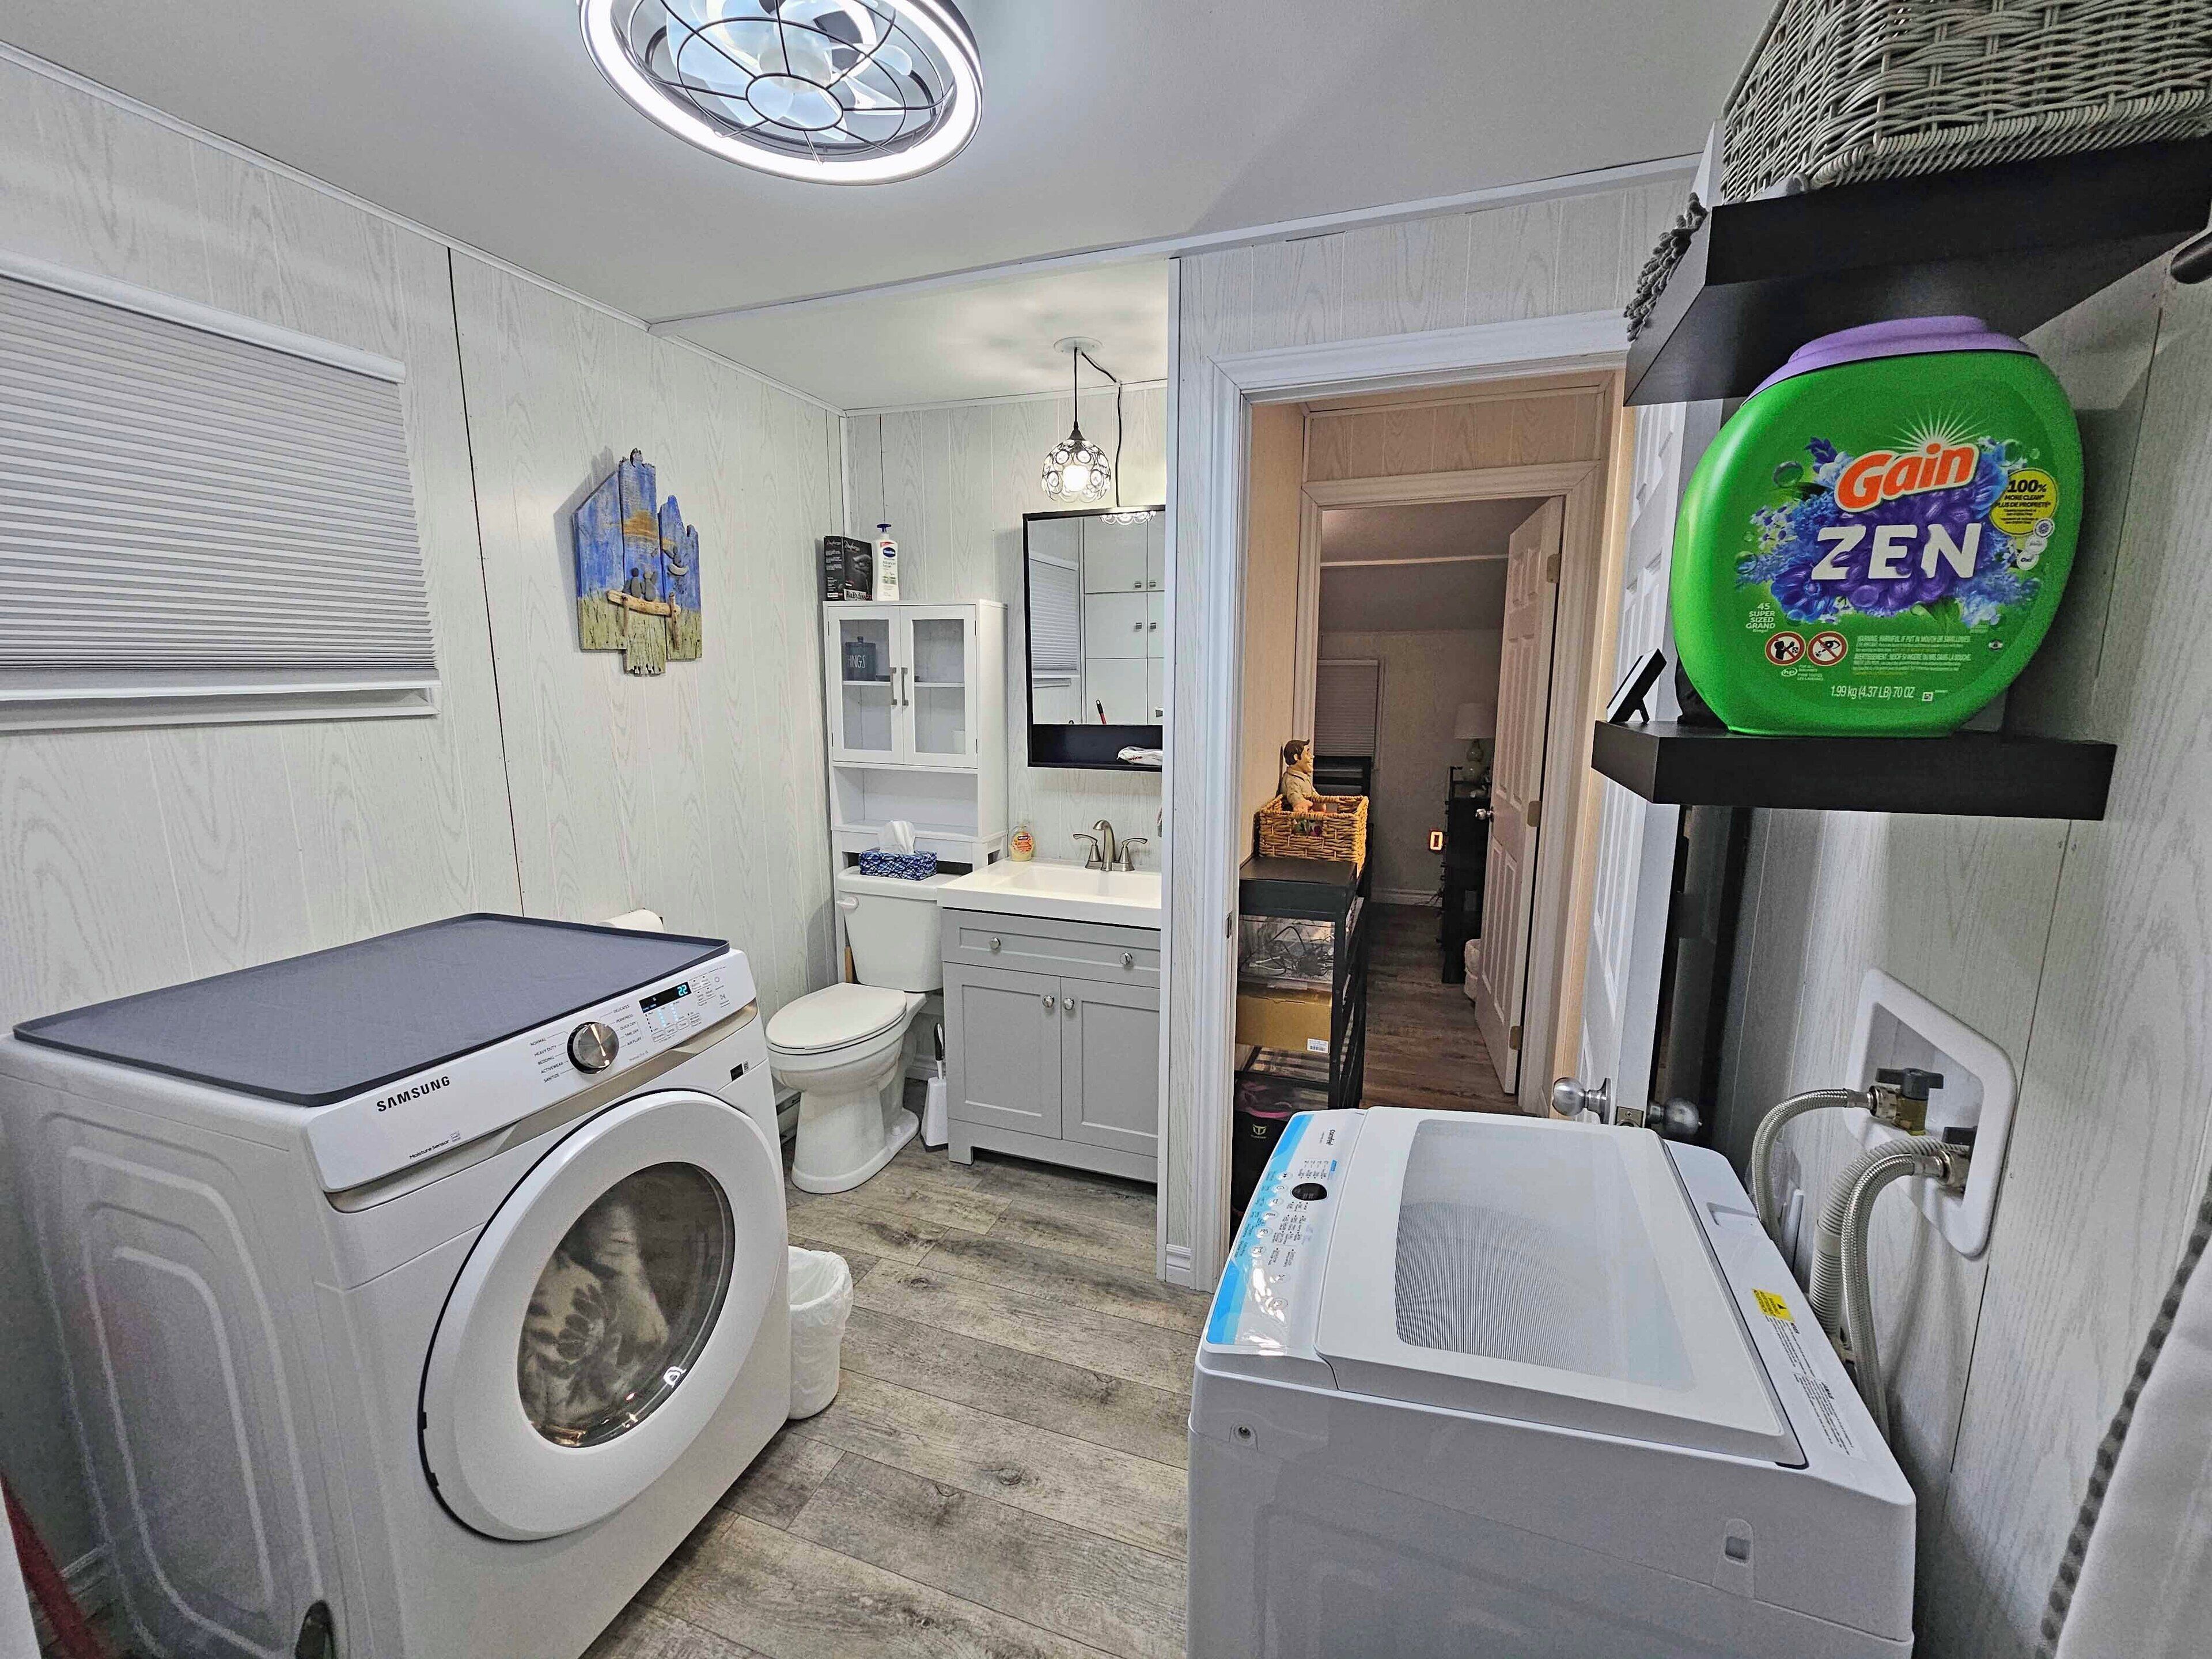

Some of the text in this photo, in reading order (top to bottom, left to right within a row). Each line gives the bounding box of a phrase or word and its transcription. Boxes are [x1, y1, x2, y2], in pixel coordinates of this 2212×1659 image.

[1838, 442, 1975, 509] Gain
[2007, 479, 2047, 493] 100%
[1811, 522, 1982, 579] ZEN
[1831, 685, 1915, 700] 1.99 kg (4.37 LB) 70 OZ
[677, 984, 688, 997] 22
[530, 1038, 547, 1046] NORMAL
[376, 1076, 450, 1112] SAMSUNG
